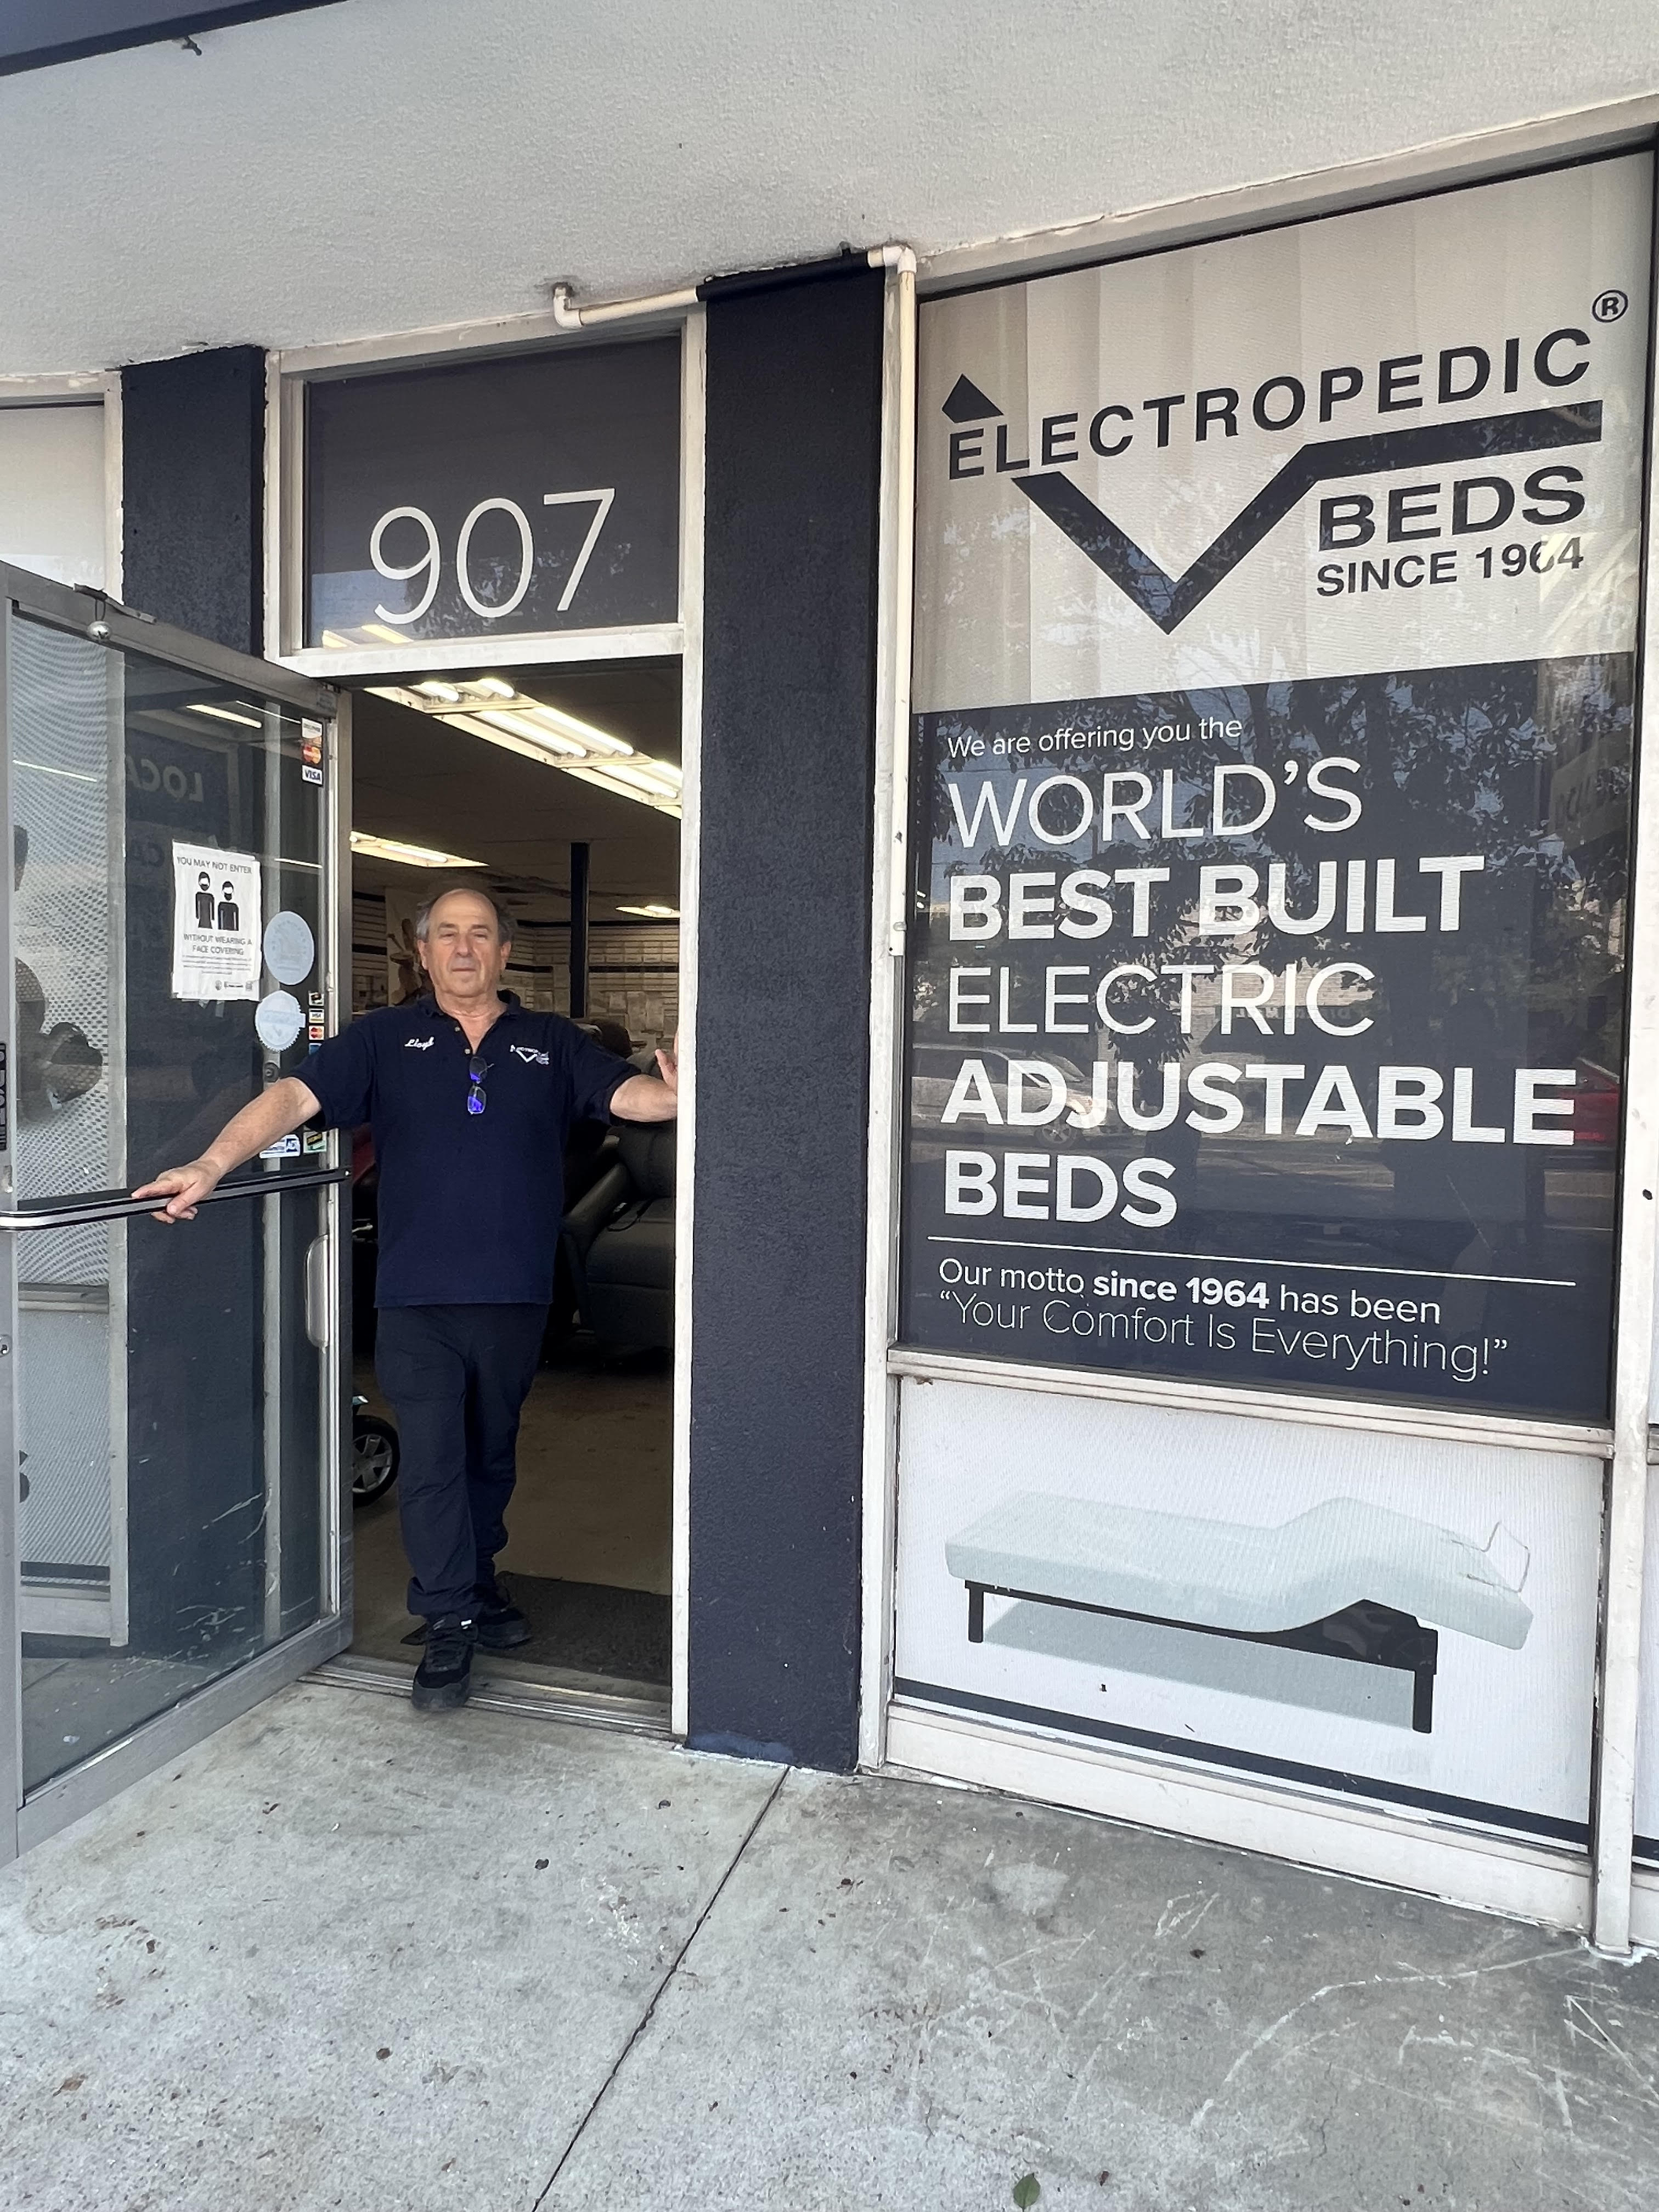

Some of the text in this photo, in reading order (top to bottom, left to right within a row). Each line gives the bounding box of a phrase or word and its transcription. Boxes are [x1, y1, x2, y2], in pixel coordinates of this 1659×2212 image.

[949, 328, 1590, 480] ELECTROPEDIC
[1319, 465, 1585, 552] BEDS
[370, 488, 615, 624] 907
[1317, 550, 1458, 596] SINCE
[304, 769, 321, 780] VISA
[948, 716, 1243, 758] We are offering you the
[948, 757, 1362, 849] WORLD’S
[177, 856, 252, 874] YOU MAY NOT ENTER
[949, 855, 1485, 941] BEST BUILT
[183, 934, 214, 943] WITHOUT
[193, 945, 244, 956] FACE COVERING
[949, 962, 1375, 1036] ELECTRIC
[940, 1059, 1576, 1146] ADJUSTABLE
[944, 1149, 1177, 1228] BEDS
[939, 1257, 1441, 1324] Our motto since 1964 has been
[939, 1289, 1508, 1383] “Your Comfort Is Everything!”
